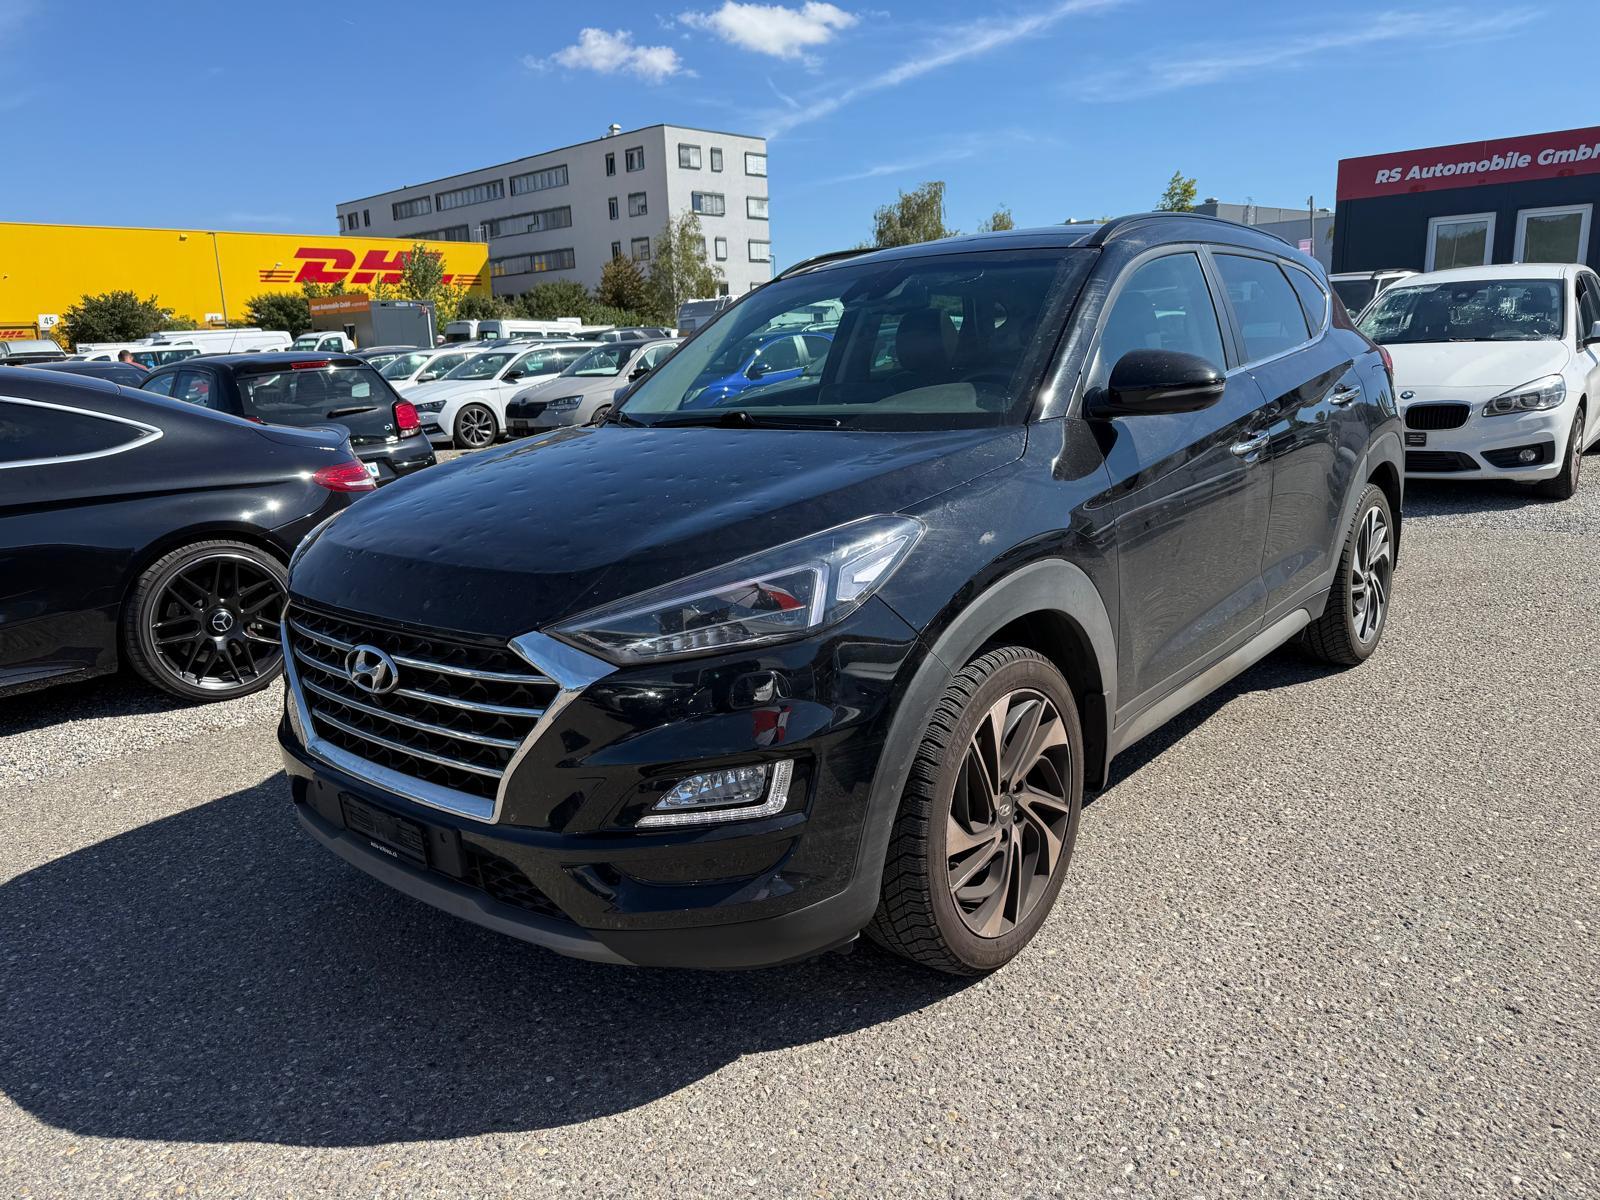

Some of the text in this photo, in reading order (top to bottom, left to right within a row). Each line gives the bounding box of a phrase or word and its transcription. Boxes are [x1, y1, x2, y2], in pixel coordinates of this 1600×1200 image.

[1375, 168, 1402, 184] RS
[1405, 152, 1531, 180] Automobile
[43, 316, 55, 325] 45
[0, 330, 26, 338] HL
